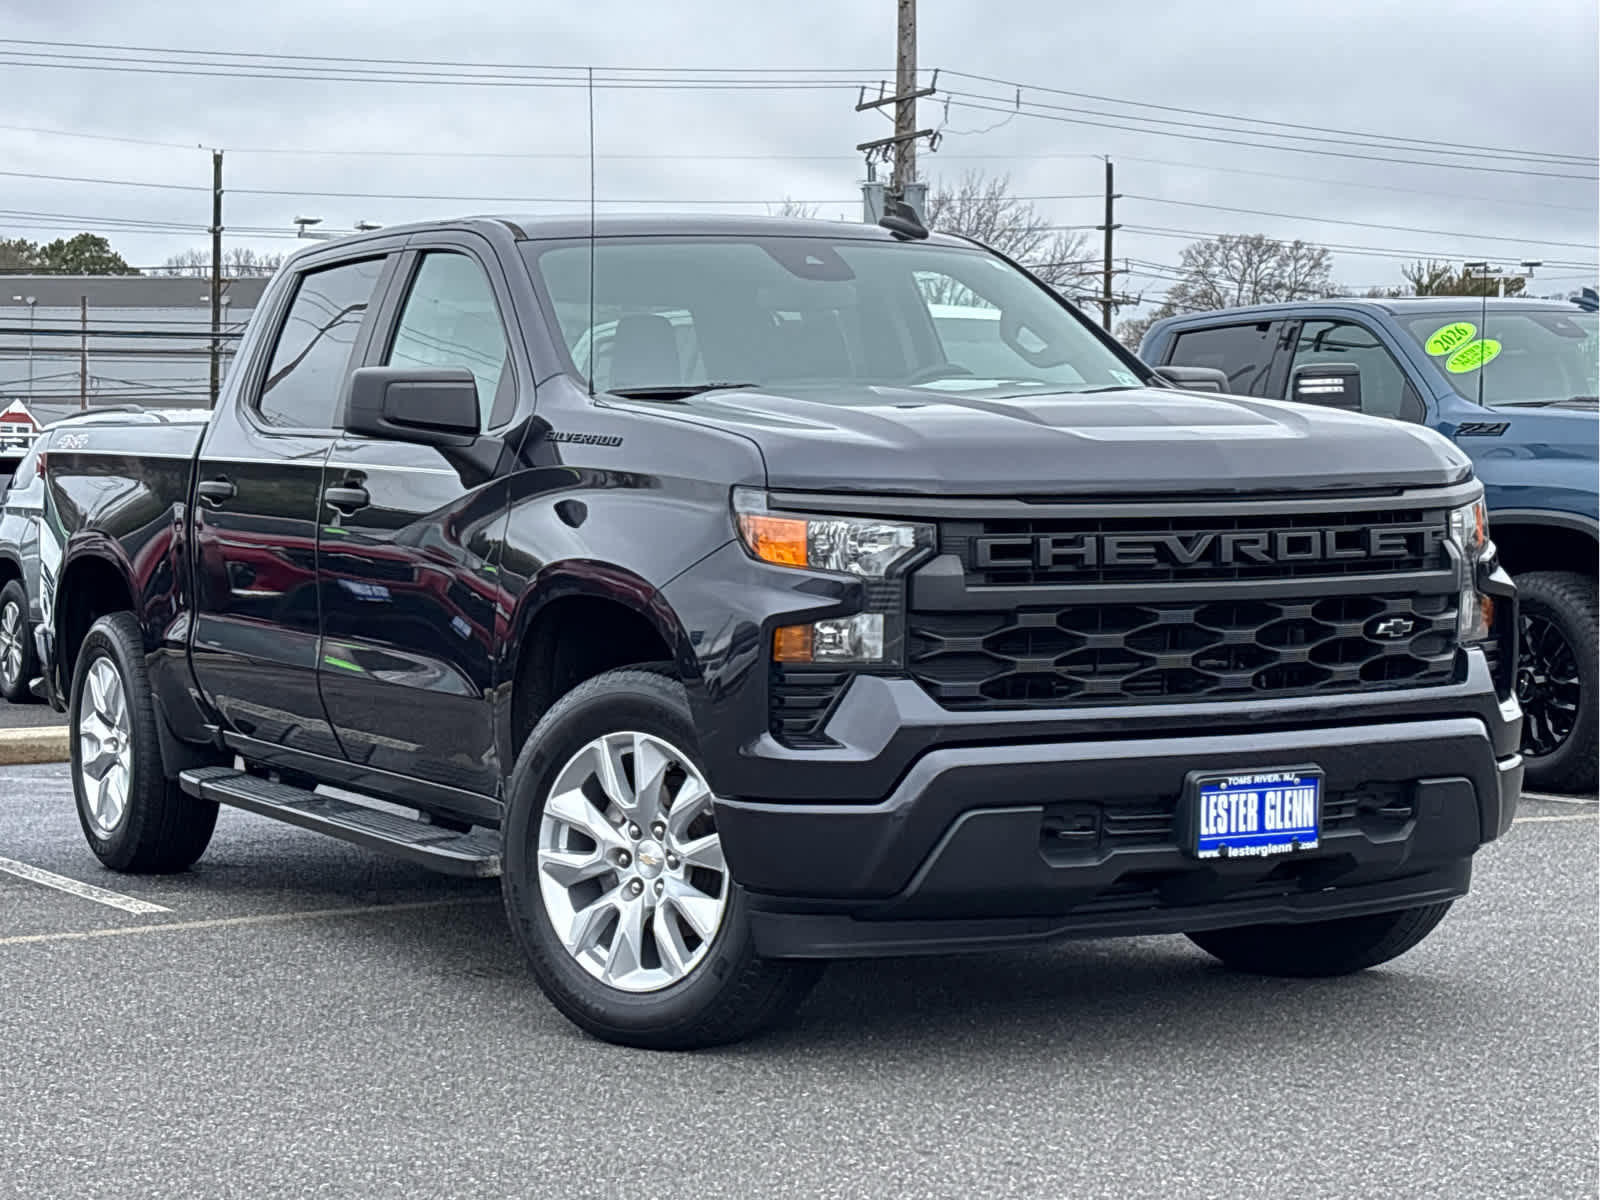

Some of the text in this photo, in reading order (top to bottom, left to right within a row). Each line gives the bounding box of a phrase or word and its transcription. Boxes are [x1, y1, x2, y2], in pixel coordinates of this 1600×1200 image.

[1433, 326, 1468, 351] 2026
[544, 431, 623, 447] SILVERADO
[976, 525, 1445, 568] CHEVROLET
[1228, 775, 1251, 785] TOMS
[1201, 788, 1314, 835] LESTER GLENN
[1228, 843, 1292, 857] lesterglenn
